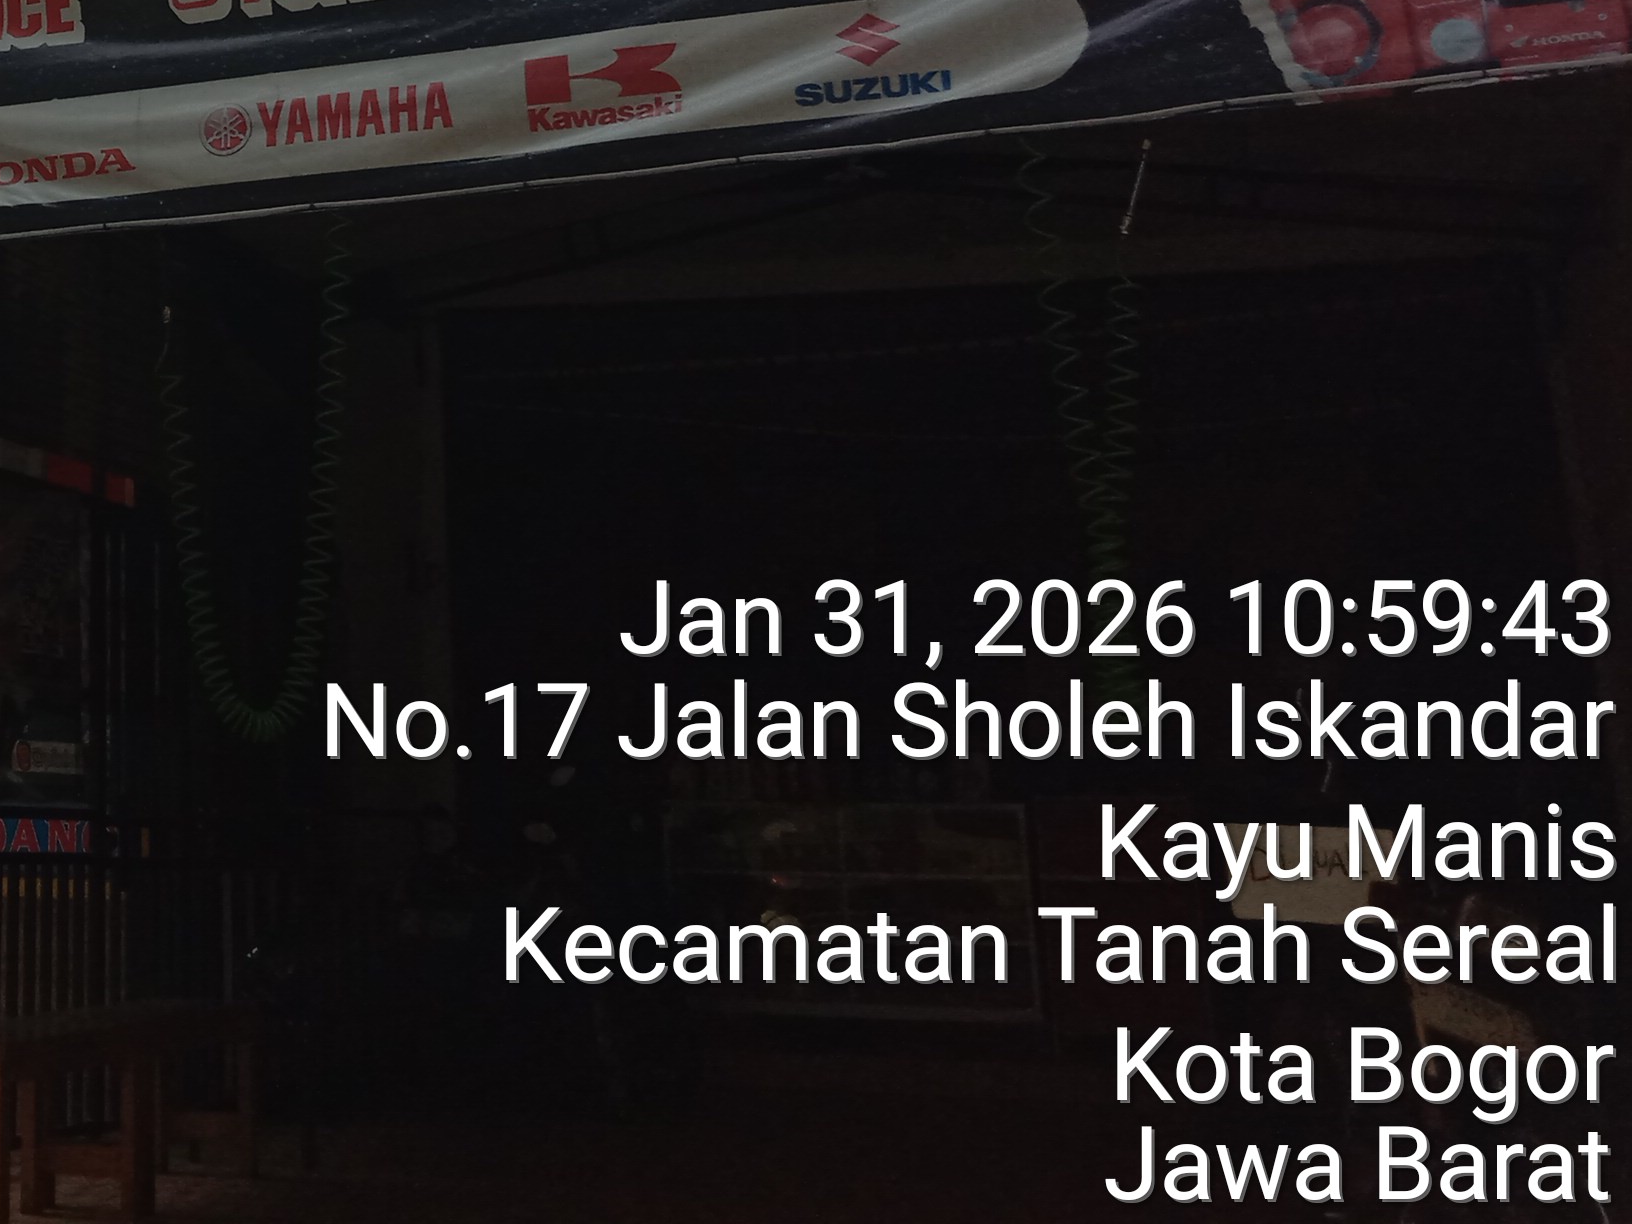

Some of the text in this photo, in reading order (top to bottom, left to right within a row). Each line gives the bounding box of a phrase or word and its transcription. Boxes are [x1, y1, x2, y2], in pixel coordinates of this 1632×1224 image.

[1531, 31, 1606, 47] HONDA
[795, 69, 951, 107] SUZUKI
[255, 81, 454, 148] YAMAHA
[528, 93, 683, 132] Kawasaki
